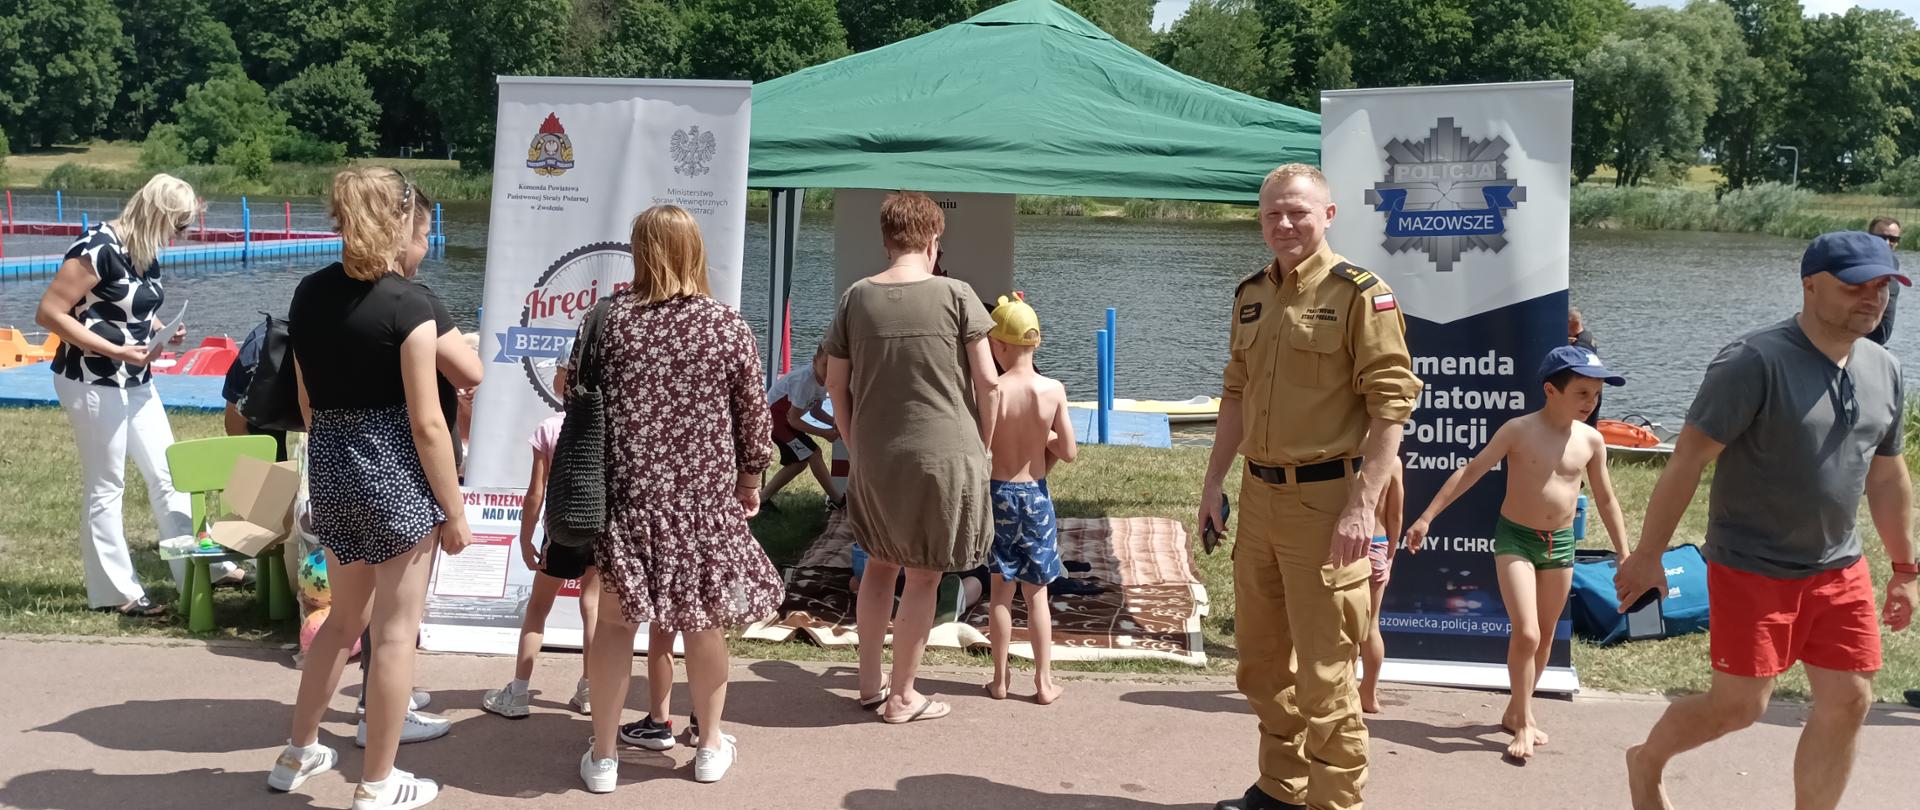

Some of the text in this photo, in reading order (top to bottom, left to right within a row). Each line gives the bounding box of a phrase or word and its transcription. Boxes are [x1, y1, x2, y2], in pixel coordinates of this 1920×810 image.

[1397, 163, 1494, 180] POLICJA
[518, 183, 580, 192] Komenda Powiatowa
[667, 187, 714, 198] Ministerstwo
[652, 195, 728, 208] Spraw Wewnętrznych
[1398, 214, 1495, 232] MAZOWSZE
[526, 279, 598, 320] Kręci
[1412, 350, 1515, 376] menda
[1400, 417, 1488, 450] Policji
[462, 490, 526, 508] YŚL TRZEŹW
[481, 507, 505, 520] NAD
[1443, 536, 1449, 551] I
[1379, 616, 1513, 635] azowiecka.policja.gov.p
